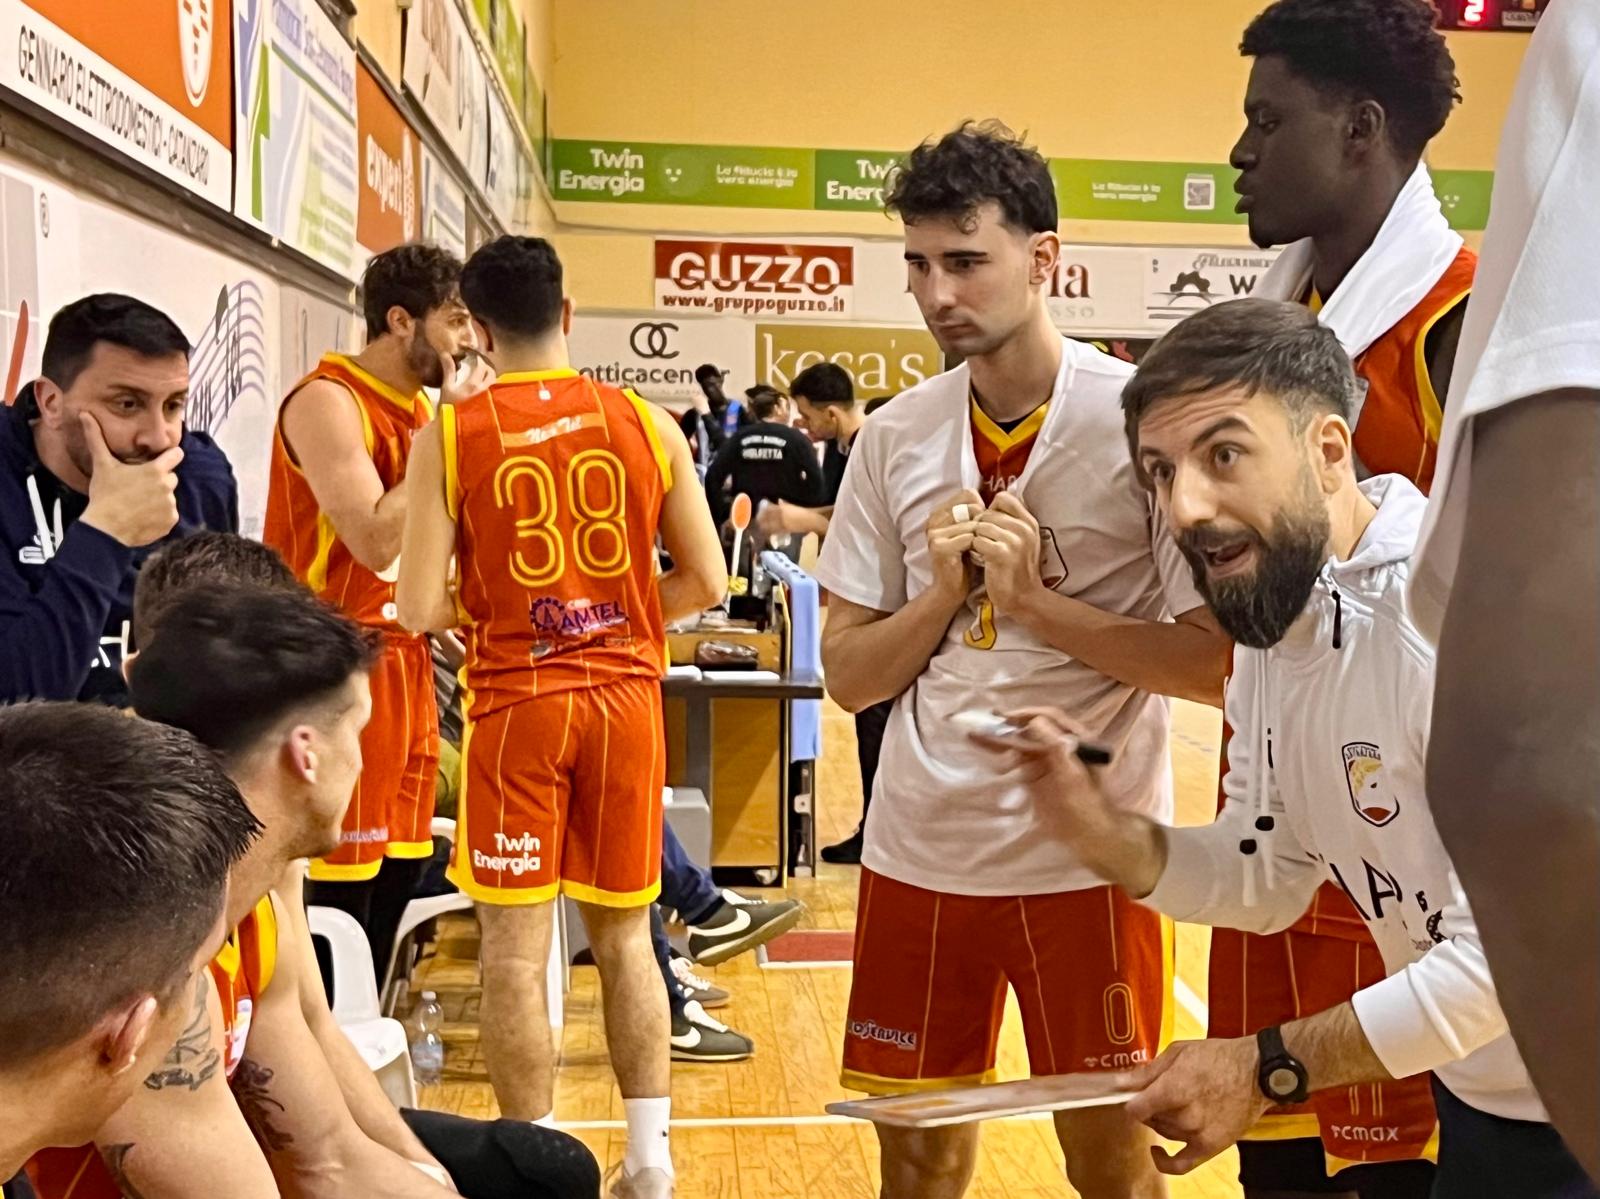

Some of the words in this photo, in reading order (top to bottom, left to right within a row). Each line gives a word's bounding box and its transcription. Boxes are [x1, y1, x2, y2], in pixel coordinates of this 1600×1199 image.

[589, 147, 644, 169] Twin
[559, 169, 645, 197] Energia
[670, 251, 841, 295] GUZZO
[662, 293, 845, 315] www.gruppoguzzo.it
[579, 361, 731, 385] otticacenr
[494, 448, 632, 588] 38
[494, 832, 541, 852] Twin
[474, 849, 541, 876] Energia
